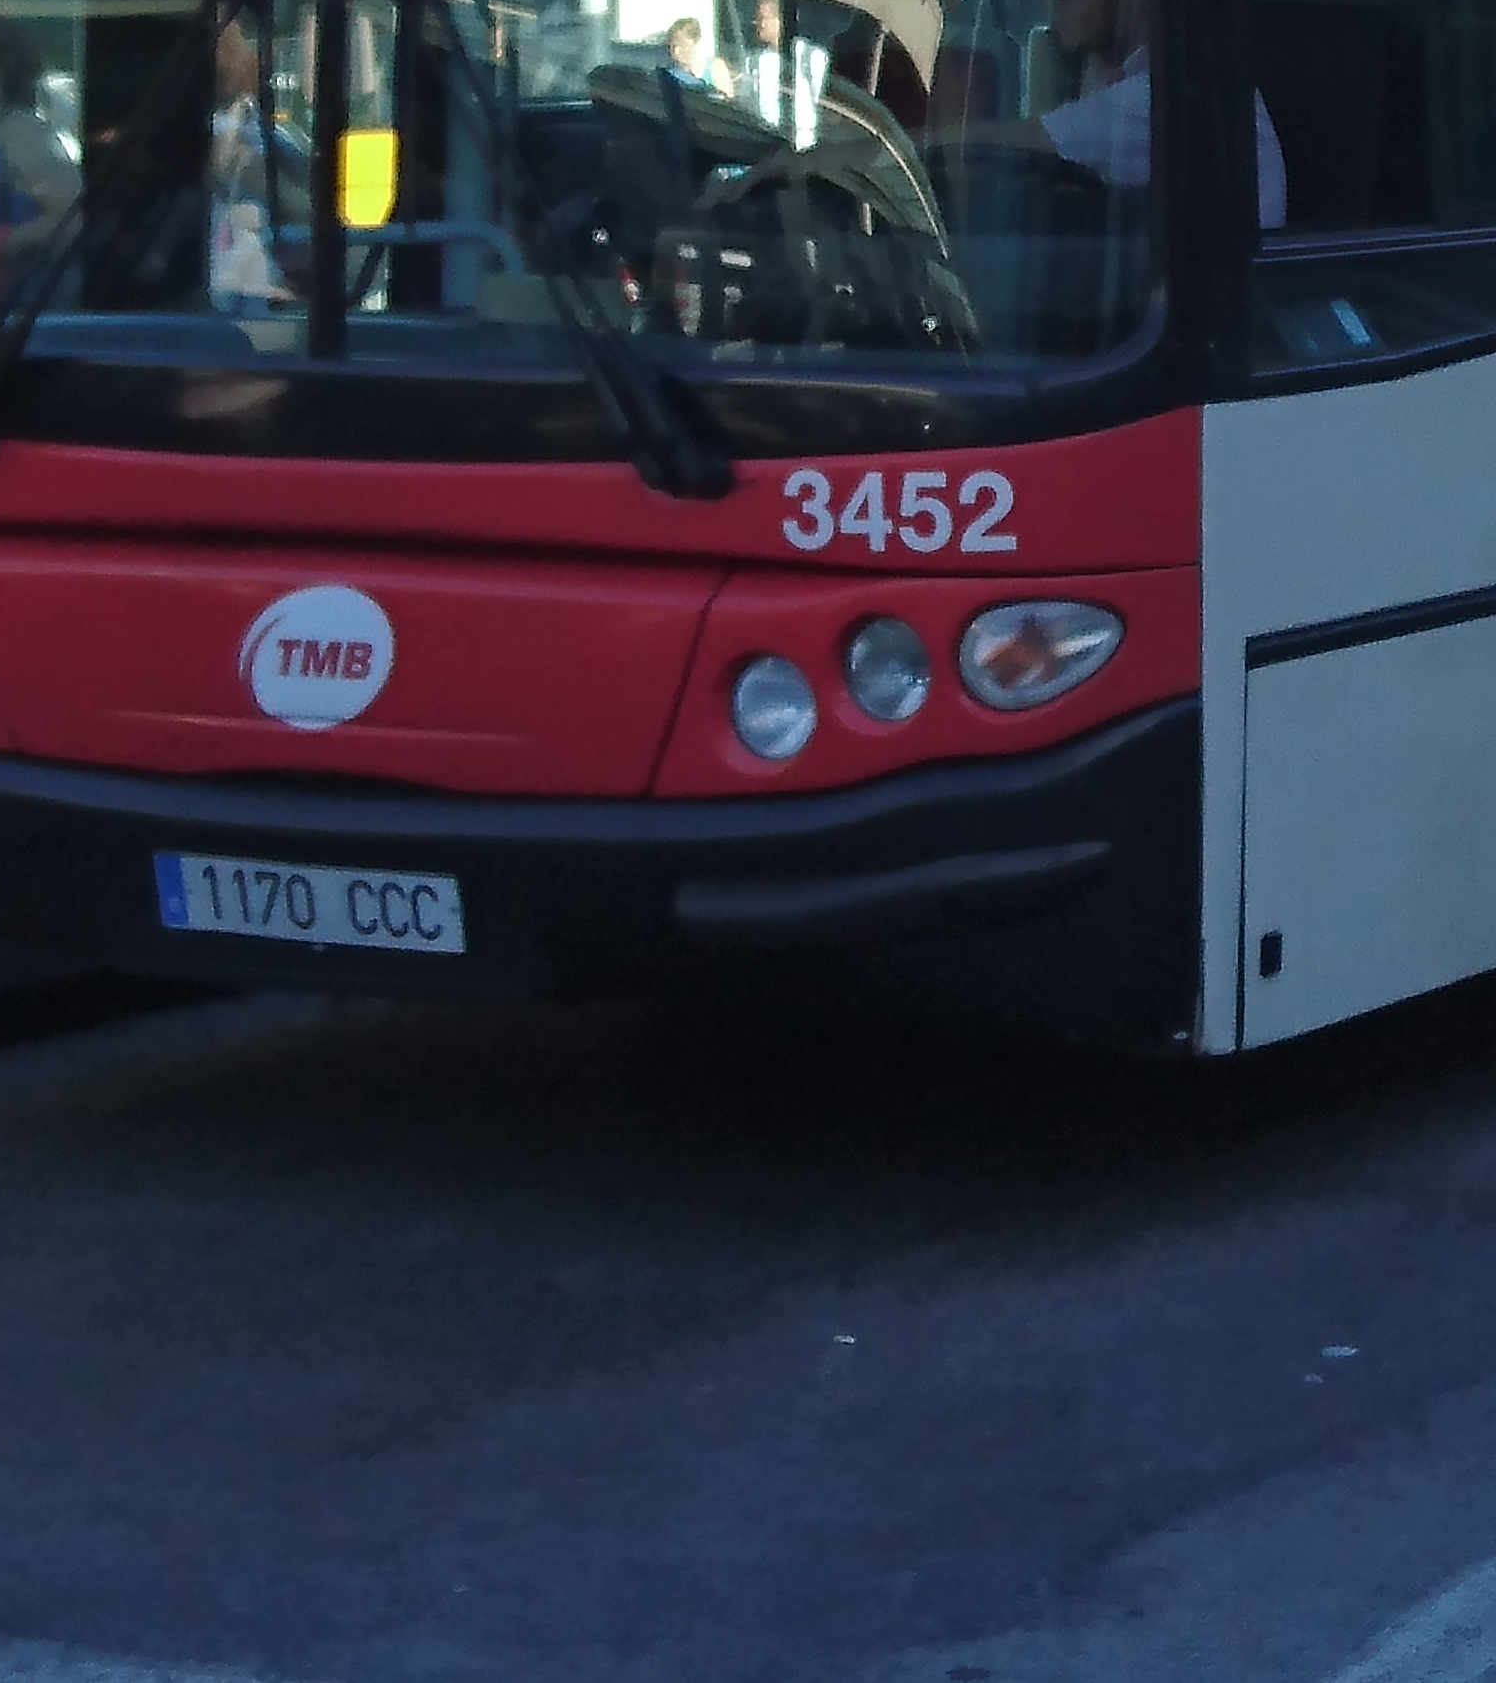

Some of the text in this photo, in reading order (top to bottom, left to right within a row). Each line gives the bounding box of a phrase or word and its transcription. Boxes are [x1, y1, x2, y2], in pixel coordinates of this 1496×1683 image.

[782, 468, 1018, 553] 3452
[277, 639, 373, 680] TMB
[201, 865, 441, 940] 1170 CCC
